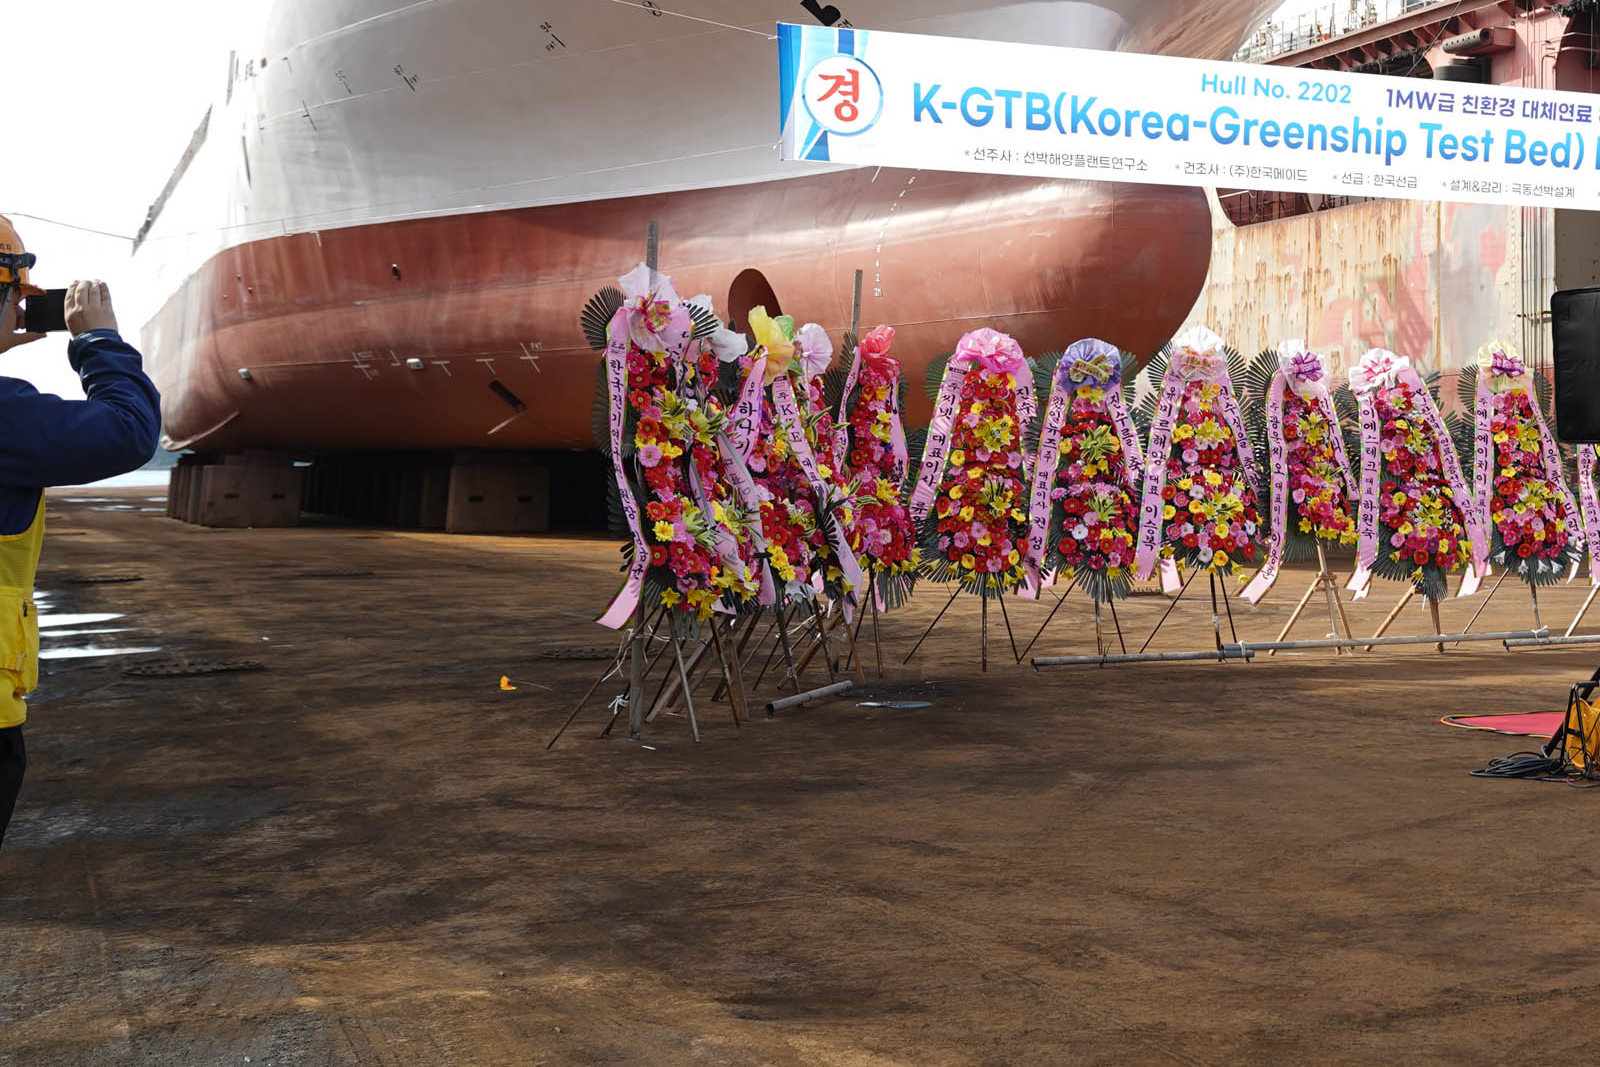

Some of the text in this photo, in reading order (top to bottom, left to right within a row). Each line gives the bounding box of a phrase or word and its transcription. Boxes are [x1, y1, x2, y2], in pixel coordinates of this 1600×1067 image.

[817, 68, 861, 123] 경
[1201, 73, 1352, 104] Hull No. 2202
[1386, 88, 1455, 113] 1MW급
[1461, 90, 1516, 118] 친환경
[1522, 100, 1593, 124] 대체연료
[913, 82, 1408, 166] K-GTB(Korea-Greenship
[1419, 122, 1495, 164] Test
[1504, 128, 1586, 171] Bed)
[973, 147, 1012, 163] 선주사
[1023, 151, 1149, 172] 선박해양플랜트연구소
[1183, 161, 1220, 177] 건조사
[1229, 164, 1308, 182] (주)한국메이드
[1341, 172, 1364, 185] 선급
[1373, 173, 1418, 189] 한국선급
[1450, 179, 1502, 194] 설계&감리
[1511, 183, 1575, 199] 극동선박설계
[920, 434, 947, 487] 대표이사
[1036, 472, 1049, 510] 대표이사
[1148, 475, 1160, 496] 대표
[1364, 478, 1374, 496] 대표
[1274, 482, 1283, 527] 대표이사
